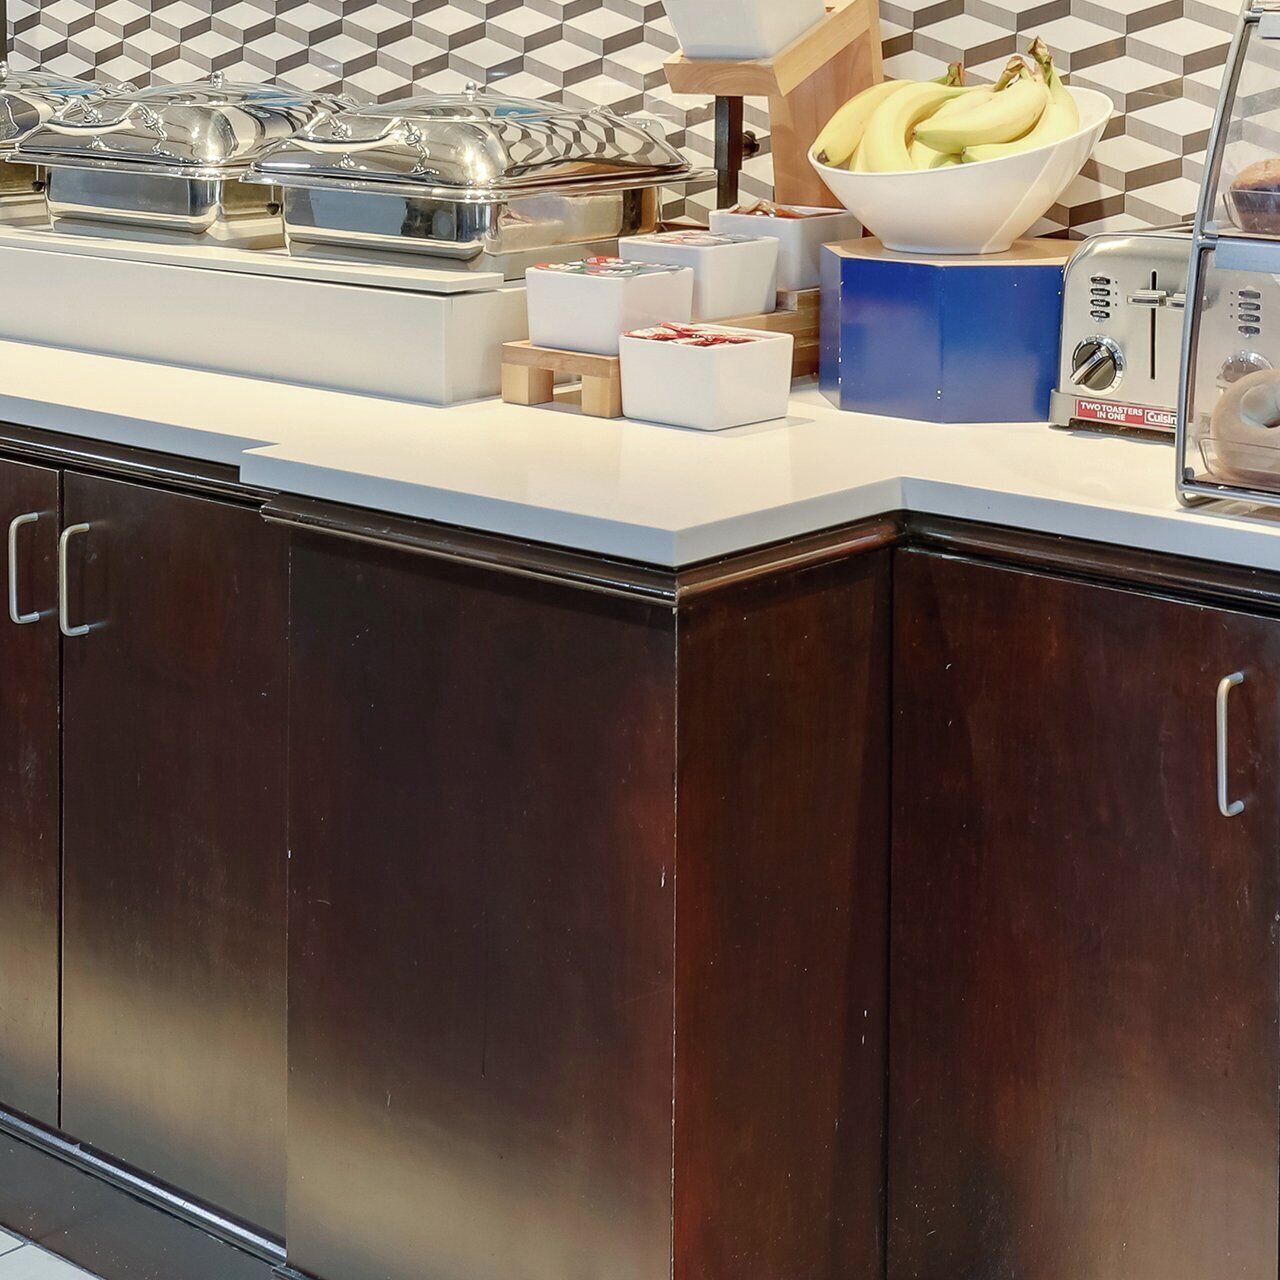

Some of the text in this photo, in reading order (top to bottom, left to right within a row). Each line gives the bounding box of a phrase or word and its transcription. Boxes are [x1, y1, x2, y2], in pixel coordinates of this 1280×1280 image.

[1080, 401, 1143, 416] TWO TOASTERS
[1096, 411, 1126, 421] IN ONE
[1147, 411, 1177, 425] Cuisin
